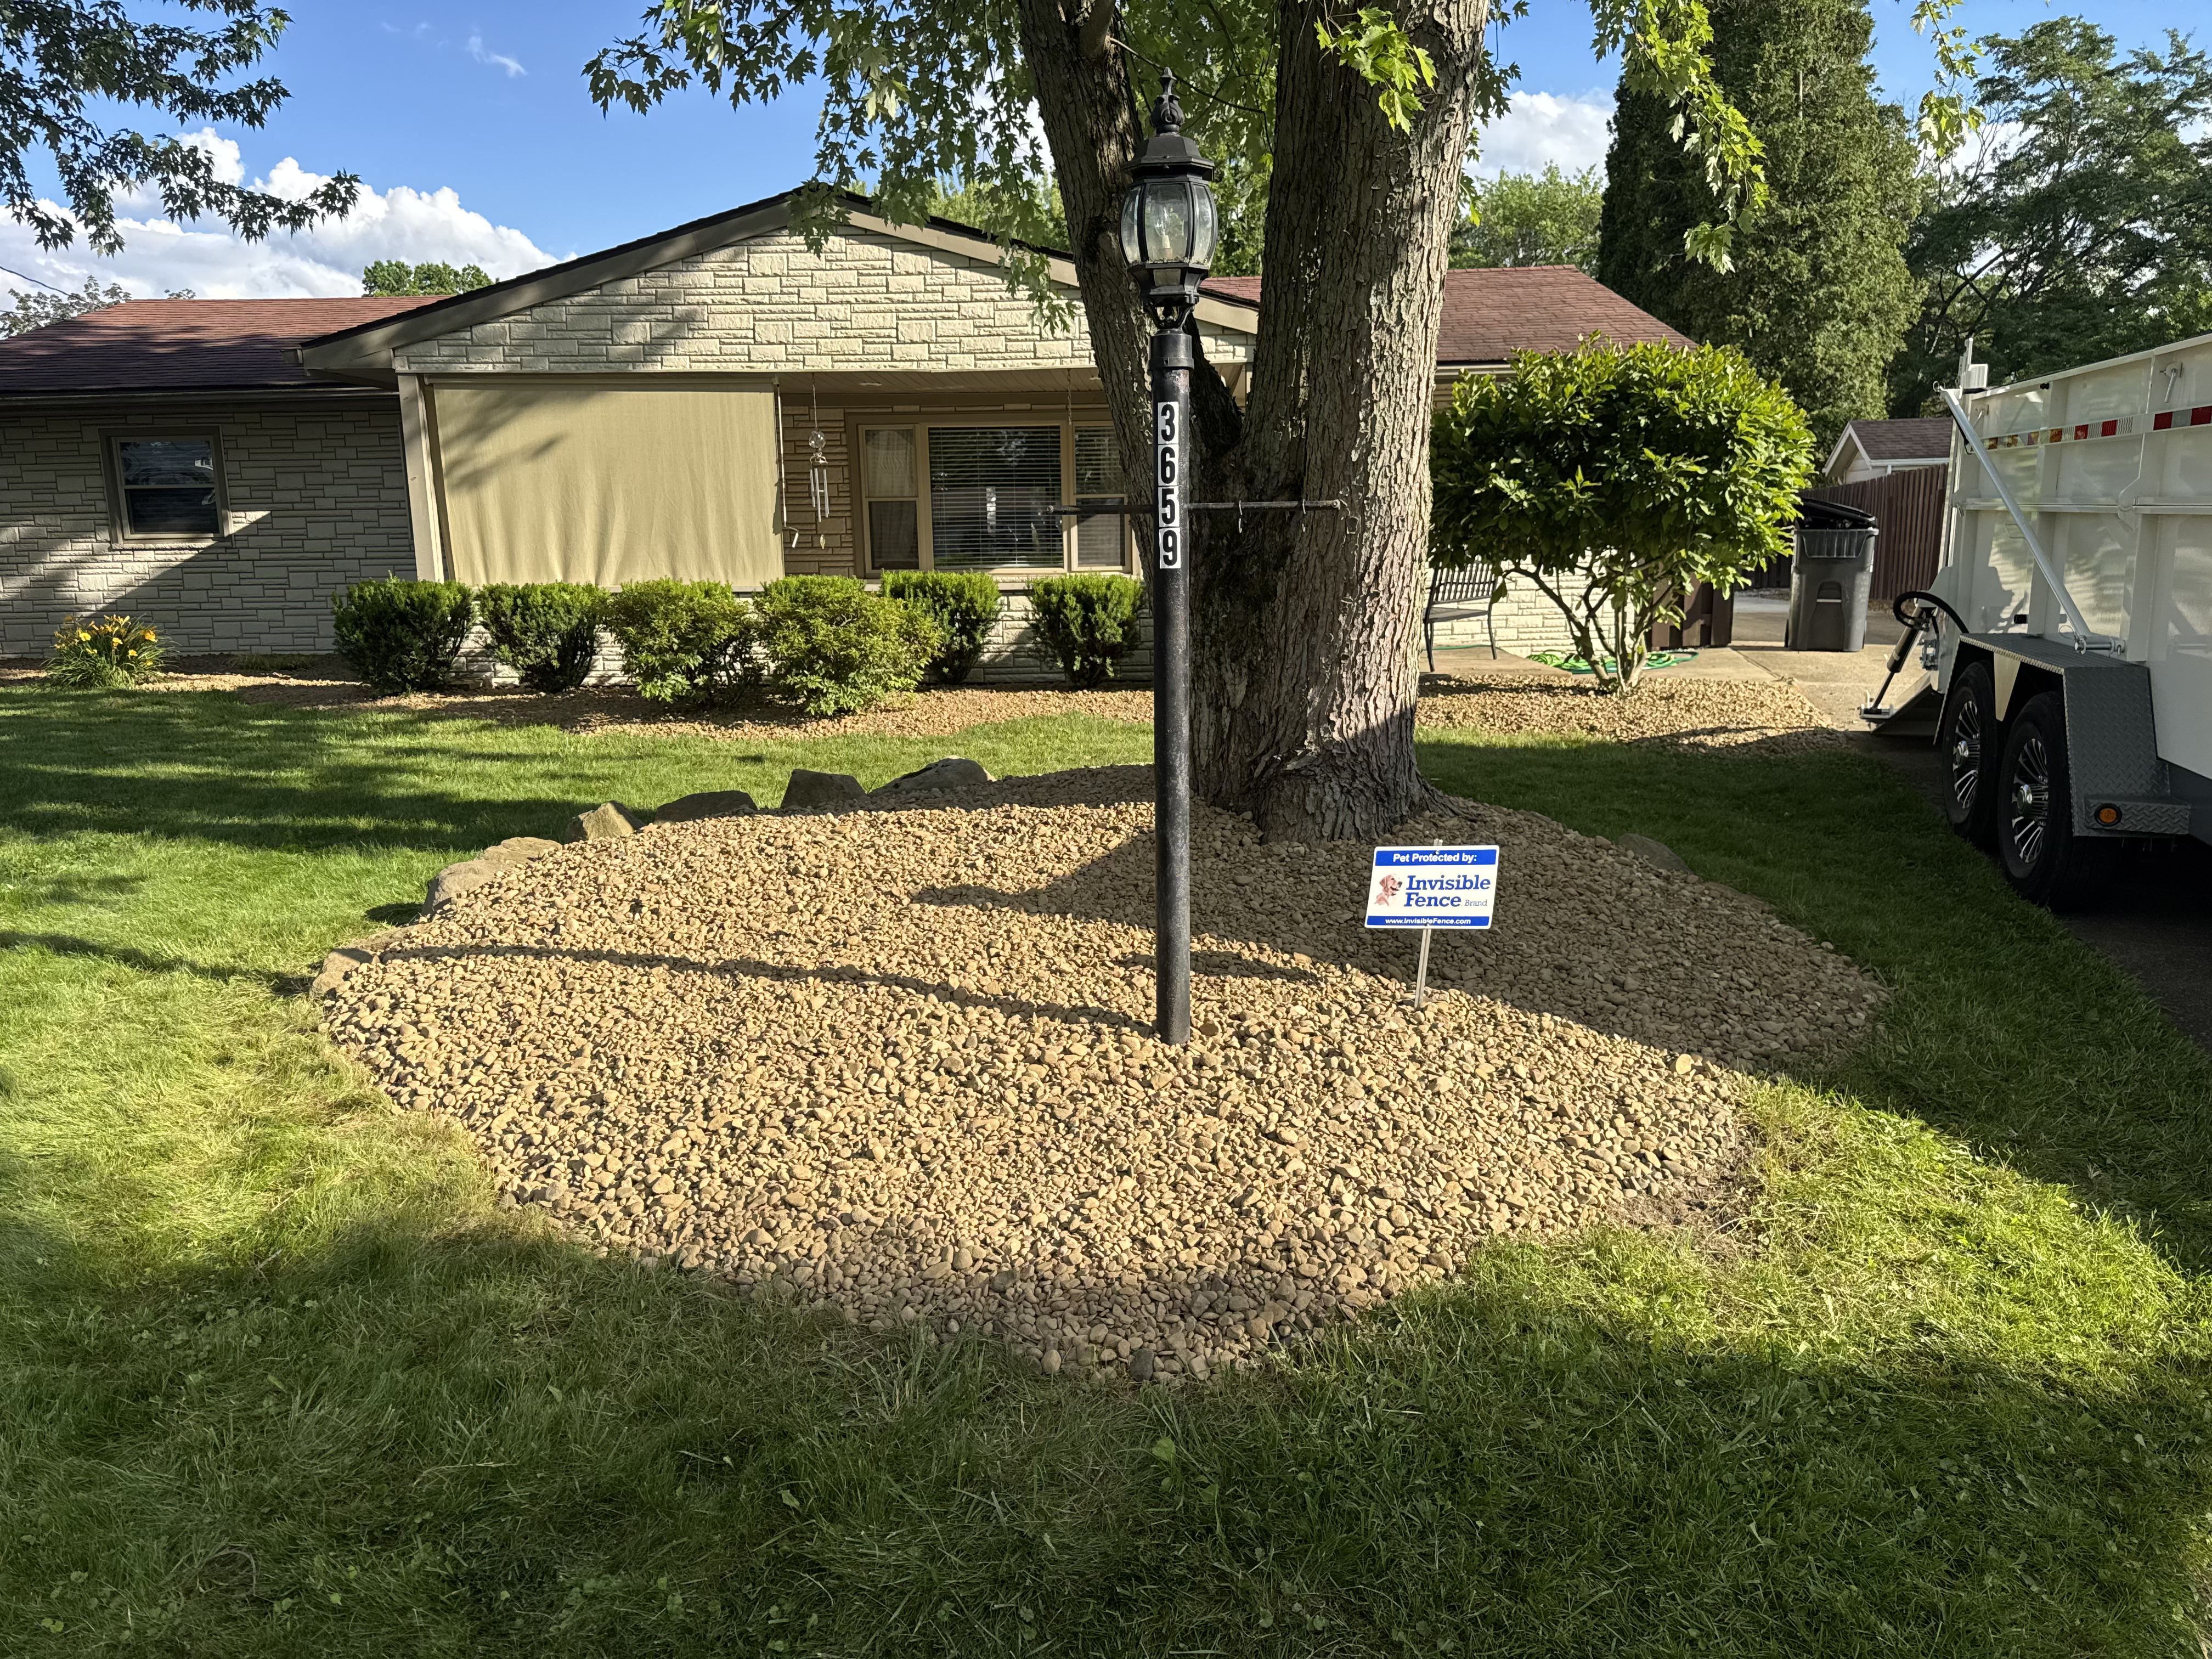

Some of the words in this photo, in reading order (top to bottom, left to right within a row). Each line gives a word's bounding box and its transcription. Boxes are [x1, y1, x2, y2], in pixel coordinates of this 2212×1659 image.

[1160, 404, 1178, 566] 3659
[1393, 853, 1410, 862] Pet
[1412, 852, 1460, 862] Protected
[1462, 852, 1477, 864] by:
[1406, 874, 1491, 890] Invisible
[1403, 892, 1462, 907] Fence
